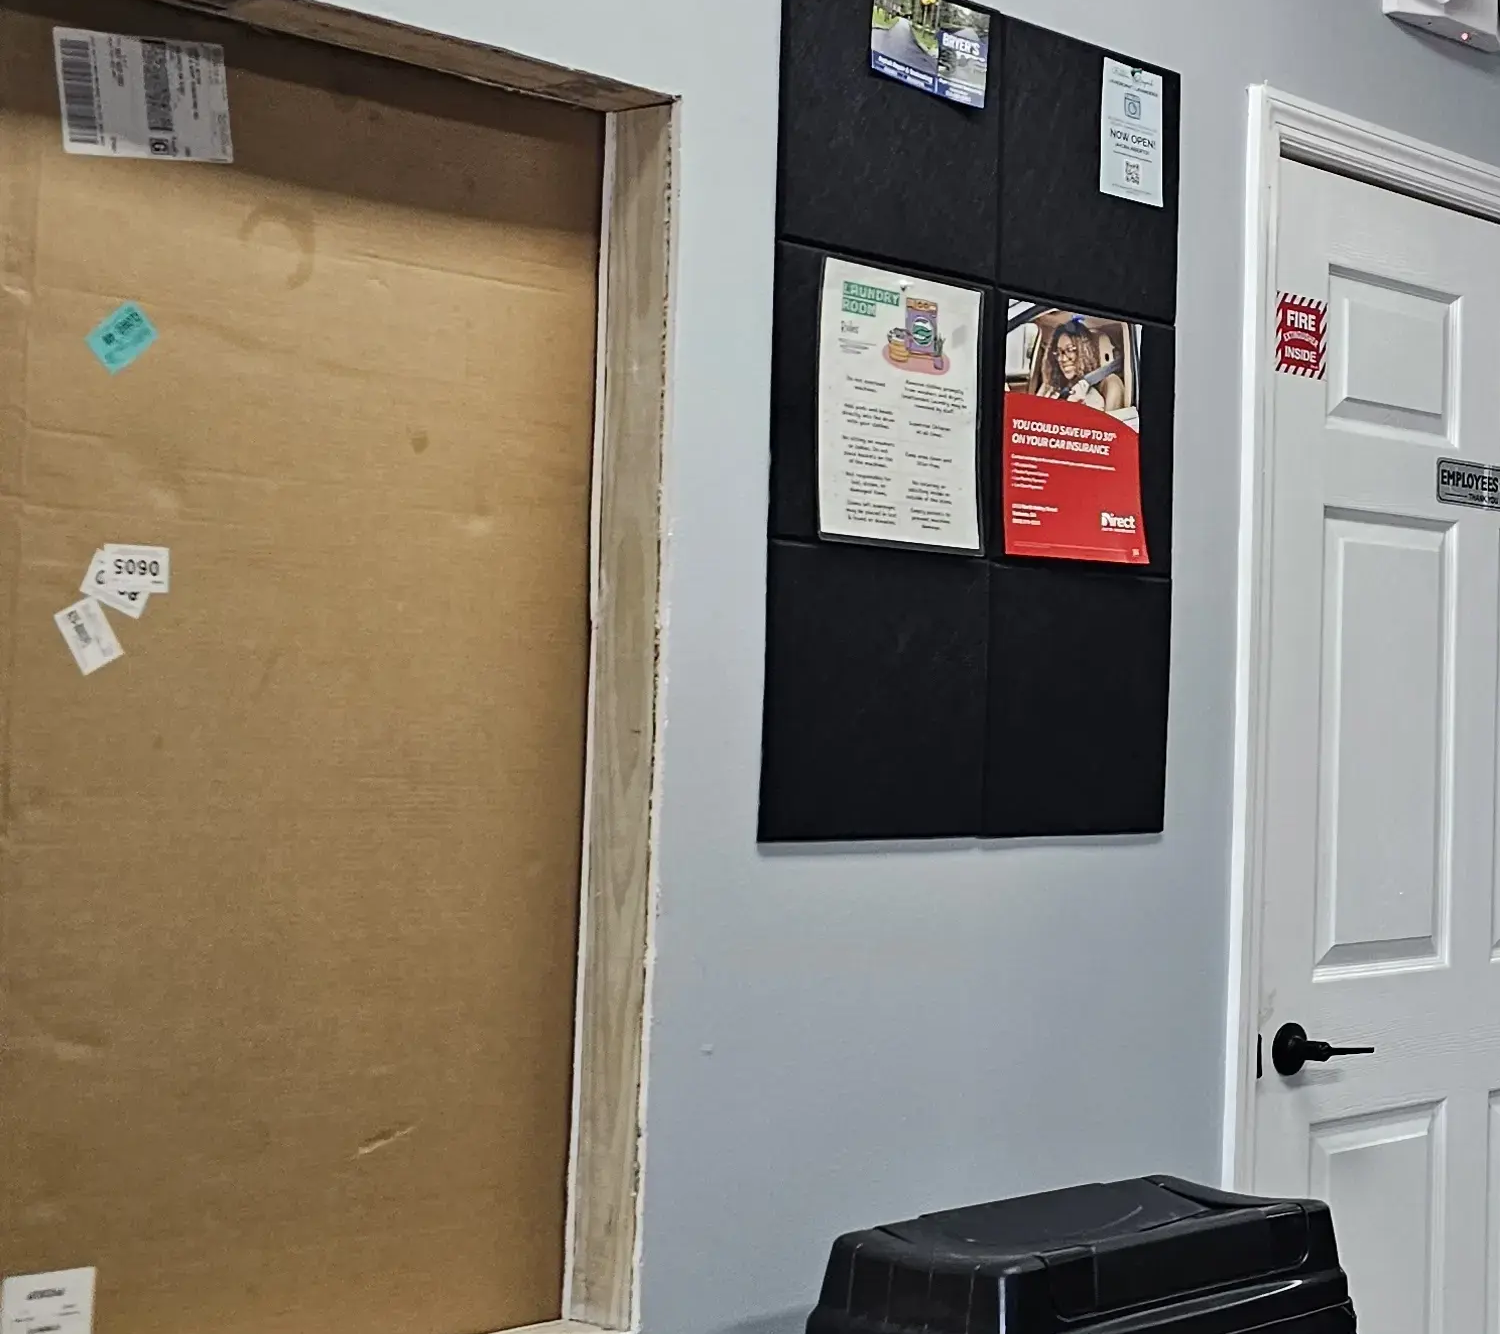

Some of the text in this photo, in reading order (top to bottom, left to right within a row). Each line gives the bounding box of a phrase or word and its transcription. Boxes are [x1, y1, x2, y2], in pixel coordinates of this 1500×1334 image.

[1110, 127, 1130, 143] NOW
[843, 282, 900, 305] LAUNDRY
[842, 299, 876, 316] ROOM
[1286, 309, 1317, 332] FIRE
[1284, 345, 1317, 363] INSIDE
[1012, 419, 1030, 430] YOU
[1030, 421, 1059, 435] COULD
[1059, 425, 1080, 437] SAVE
[1080, 428, 1091, 439] UP
[1091, 430, 1103, 441] TO
[1011, 433, 1110, 456] ON YOUR CAR INSURANCE
[1441, 469, 1499, 493] EMPLOYEES
[1101, 512, 1136, 529] Direct
[113, 559, 160, 577] 0605
